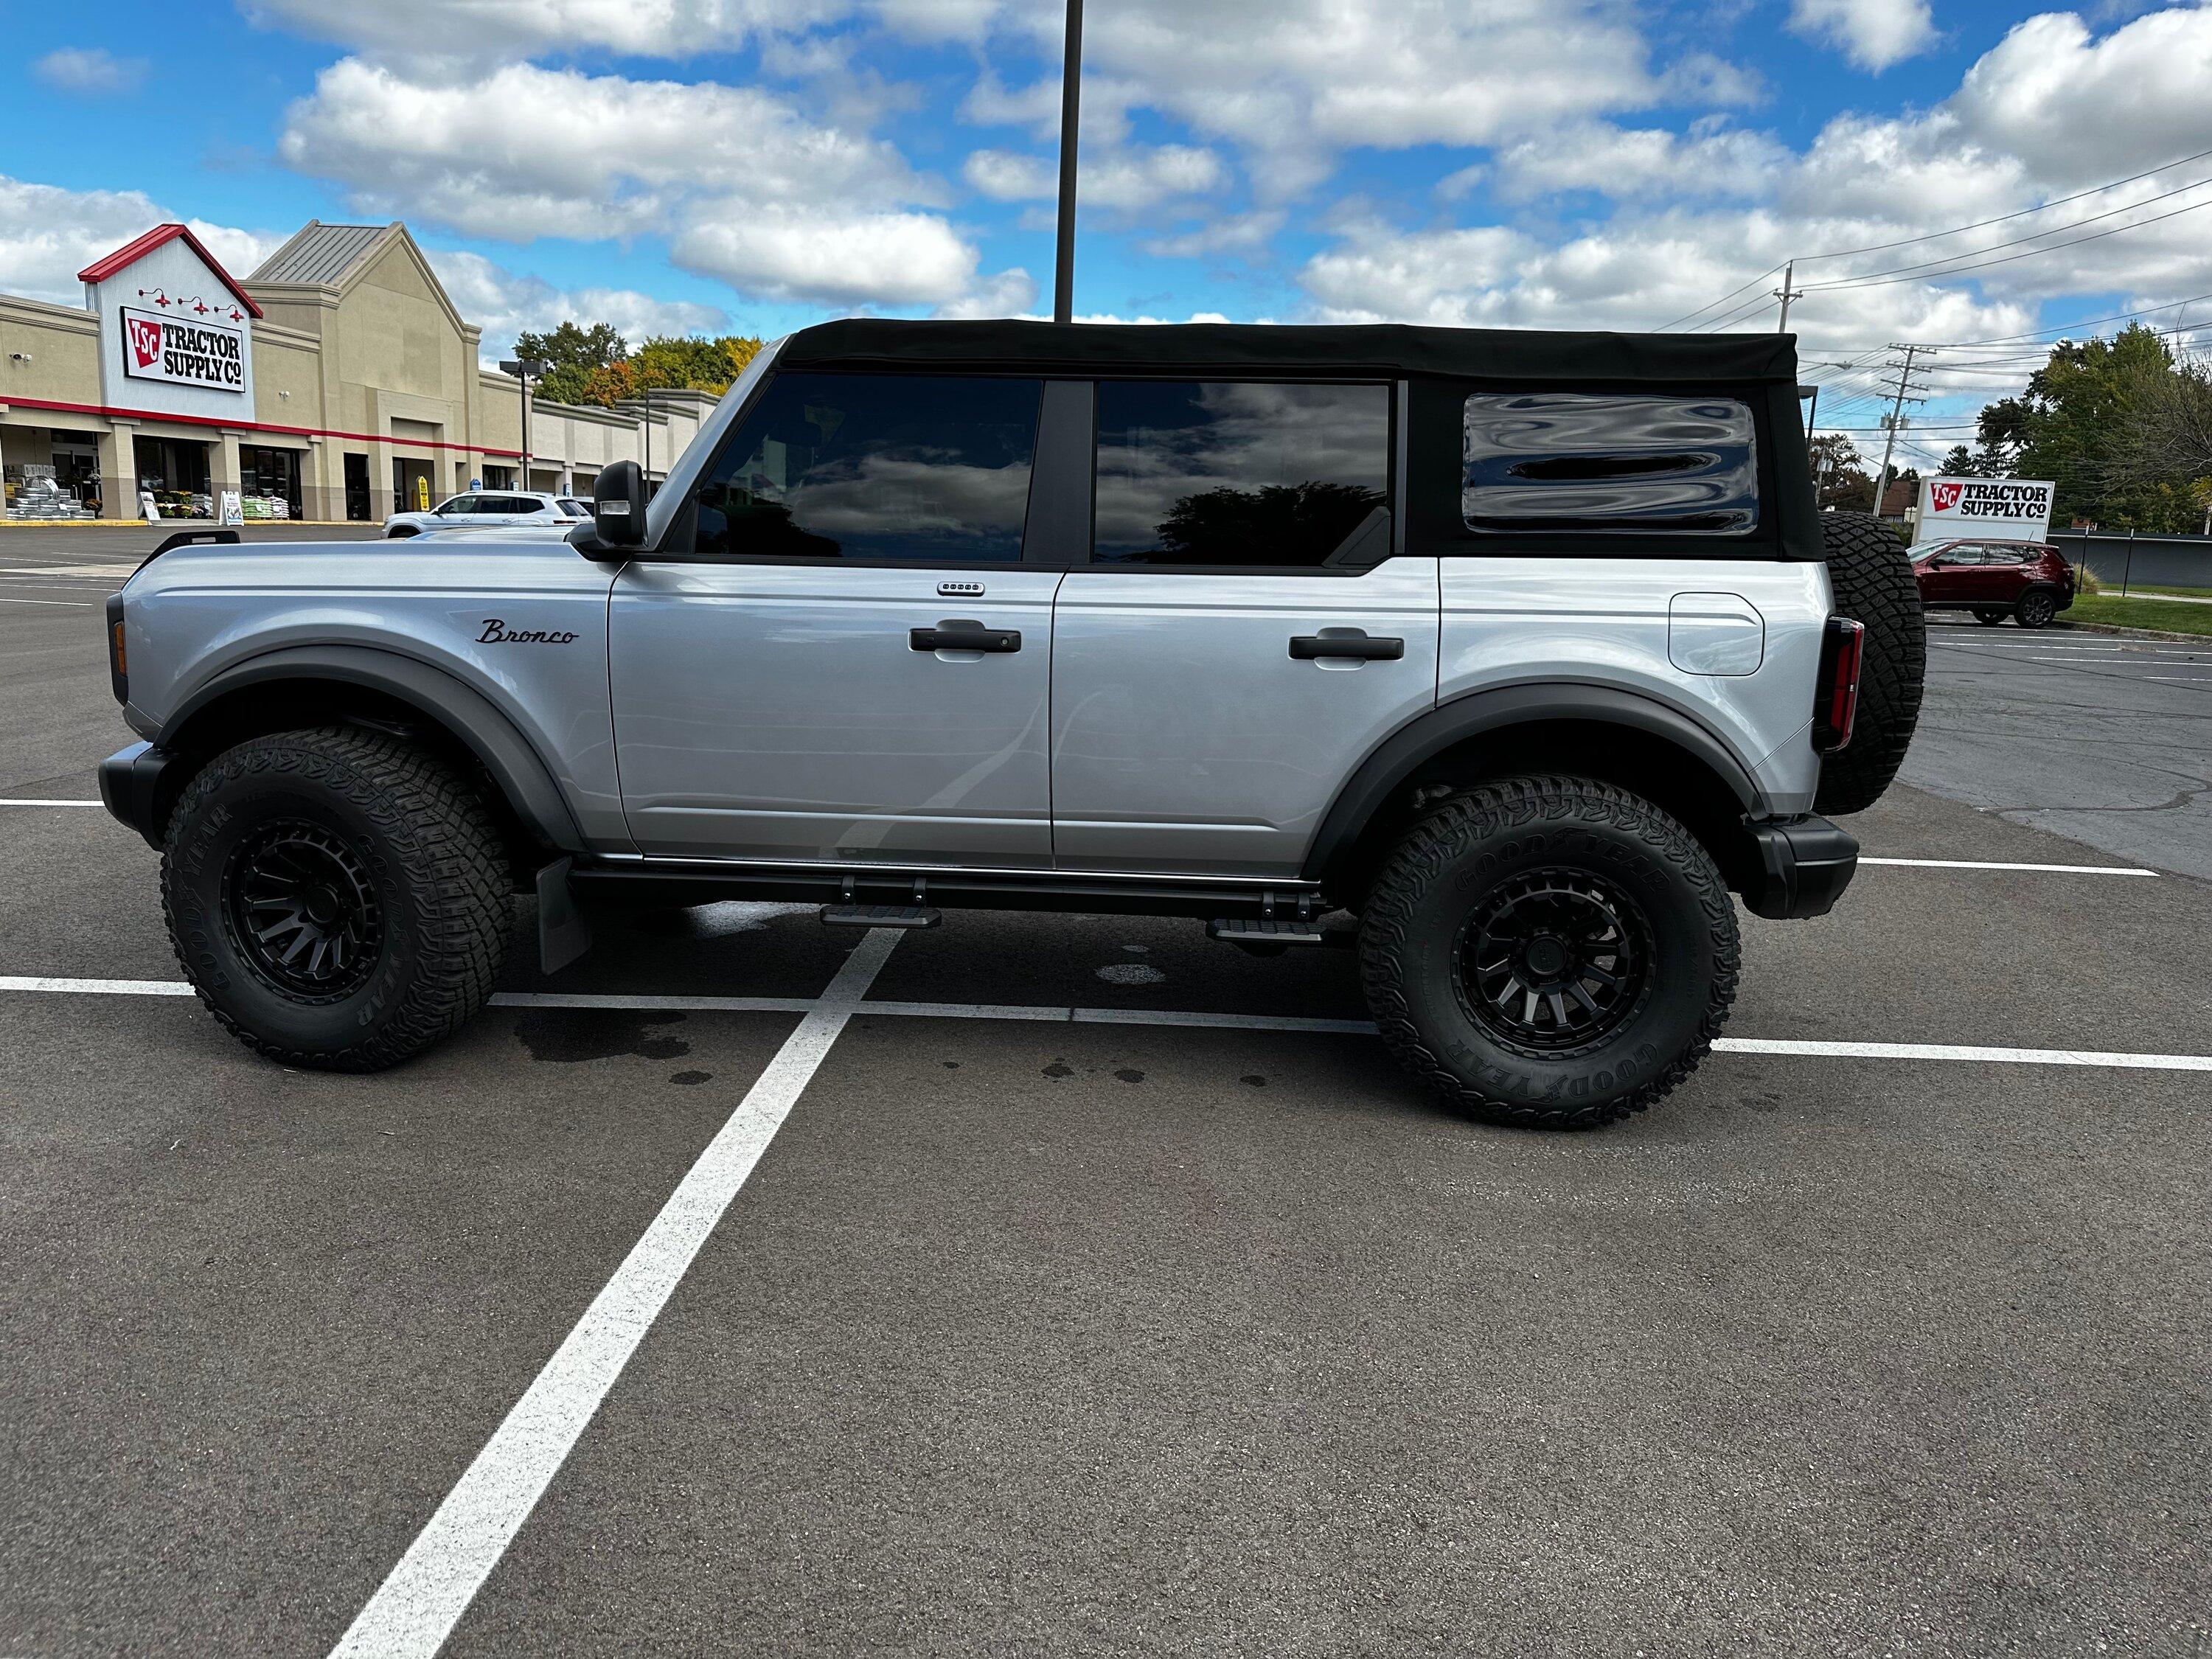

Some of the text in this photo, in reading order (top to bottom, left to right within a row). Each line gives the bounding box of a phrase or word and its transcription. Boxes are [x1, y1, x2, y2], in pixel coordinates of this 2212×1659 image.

[132, 321, 158, 361] TSC
[162, 323, 240, 360] TRACTOR
[164, 350, 223, 383] SUPPLY
[1933, 484, 1957, 507] TSC
[1964, 484, 2048, 502] TRACTOR
[1961, 500, 2026, 518] SUPPLY
[475, 619, 580, 644] Bronco
